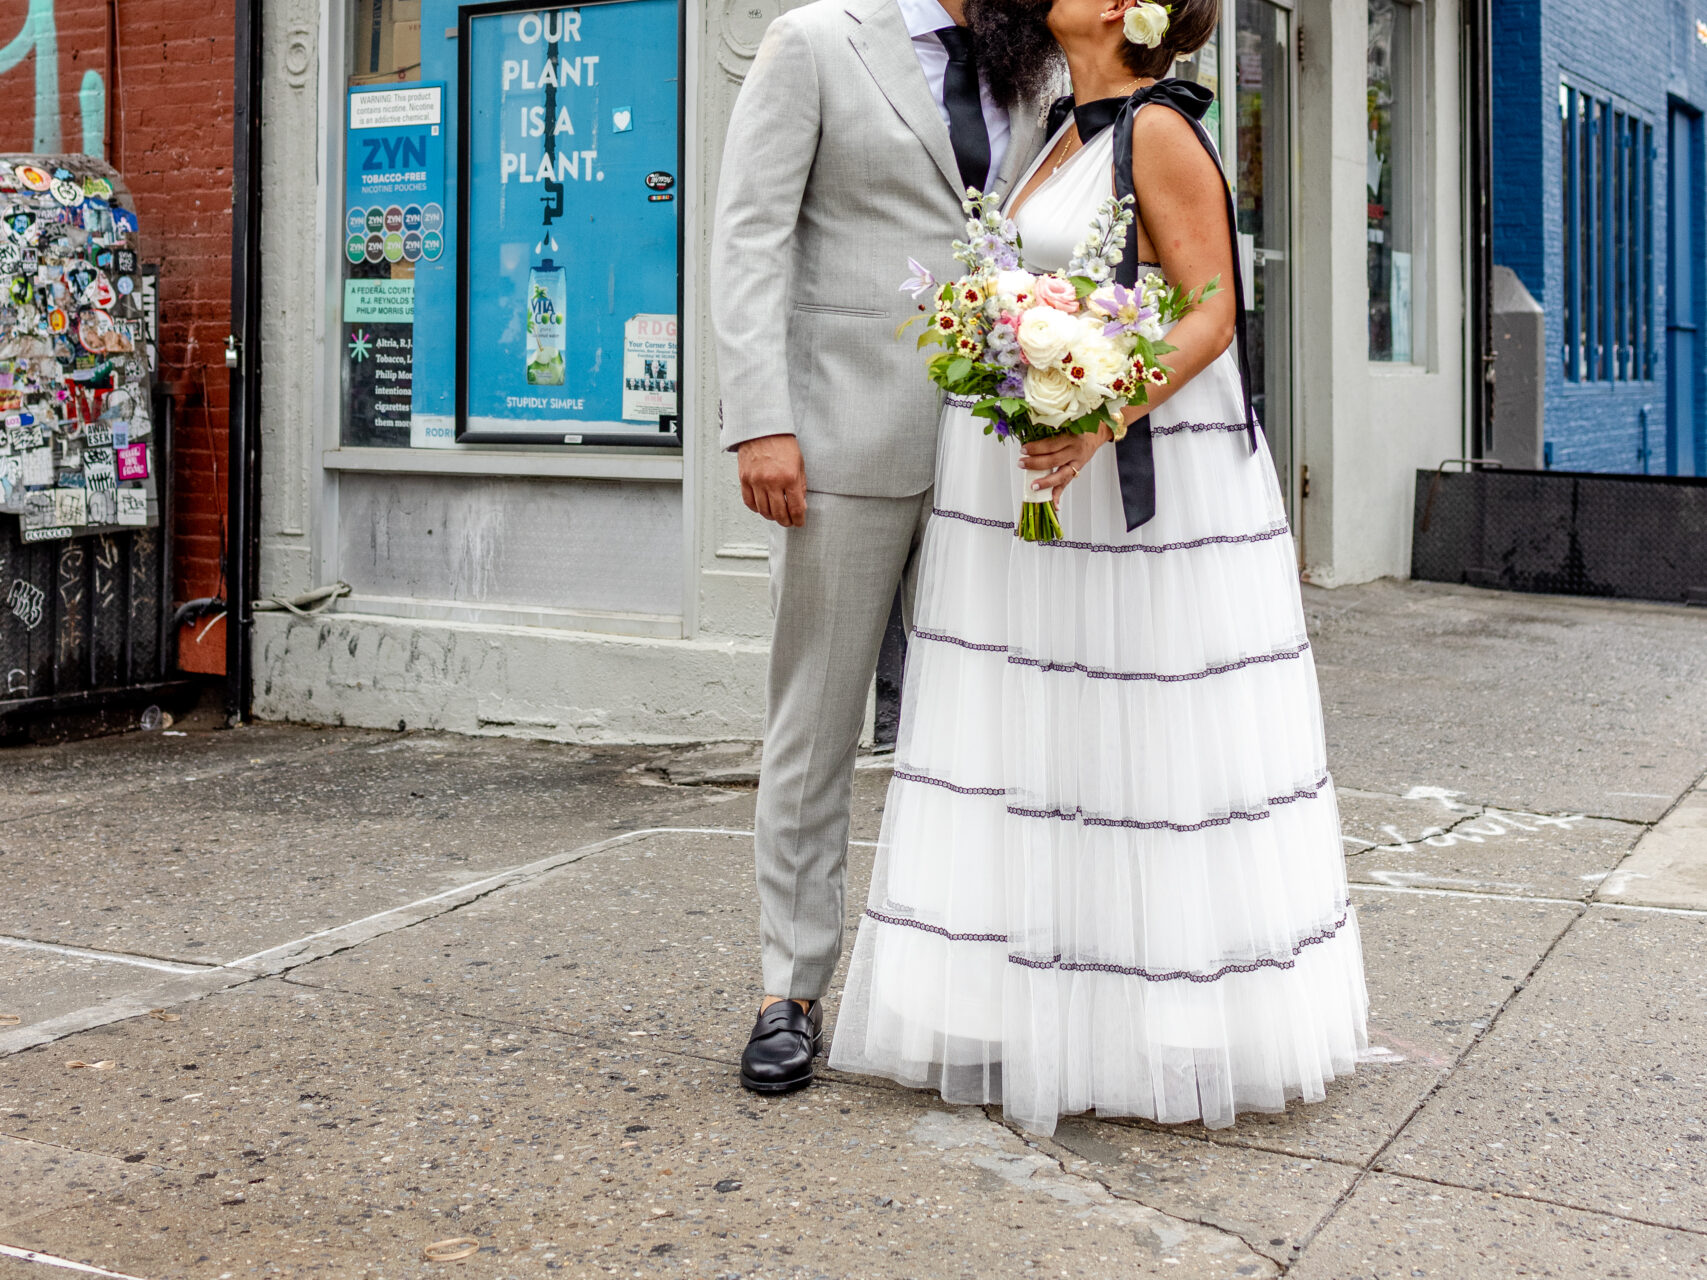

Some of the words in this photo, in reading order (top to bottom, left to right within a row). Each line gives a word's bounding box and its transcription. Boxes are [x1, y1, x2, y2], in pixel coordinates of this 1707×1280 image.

[518, 11, 582, 44] OUR
[503, 56, 599, 91] PLANT
[394, 93, 406, 102] This
[408, 92, 431, 103] product
[357, 105, 381, 115] contains
[409, 102, 434, 112] Nicotine
[521, 106, 545, 138] IS
[553, 105, 575, 136] A
[362, 135, 426, 171] ZYN
[502, 150, 605, 184] PLANT.
[361, 172, 427, 184] TOBACCO-FREE
[362, 184, 393, 194] NICOTINE
[394, 182, 427, 193] POUCHES
[368, 215, 383, 224] ZYN
[387, 214, 401, 224] ZYN
[405, 214, 420, 223] ZYN
[350, 242, 364, 252] ZYN
[368, 242, 383, 251] ZYN
[405, 240, 421, 250] ZYN
[424, 238, 440, 249] ZYN
[357, 286, 387, 295] FEDERAL
[388, 286, 411, 295] COURT
[360, 297, 373, 305] R.J.
[373, 297, 410, 305] REYNOLDS
[356, 307, 377, 315] PHILIP
[378, 307, 404, 315] MORRIS
[531, 299, 554, 315] VITA
[535, 312, 562, 325] COCO
[375, 338, 400, 349] Altria,
[400, 338, 413, 348] R.J.
[645, 341, 666, 349] Corner
[375, 354, 406, 365] Tobacco,
[375, 370, 397, 381] Philip
[375, 401, 410, 412] cigarettes
[506, 396, 548, 409] STUPIDLY
[550, 397, 584, 410] SIMPLE
[375, 418, 394, 428] them
